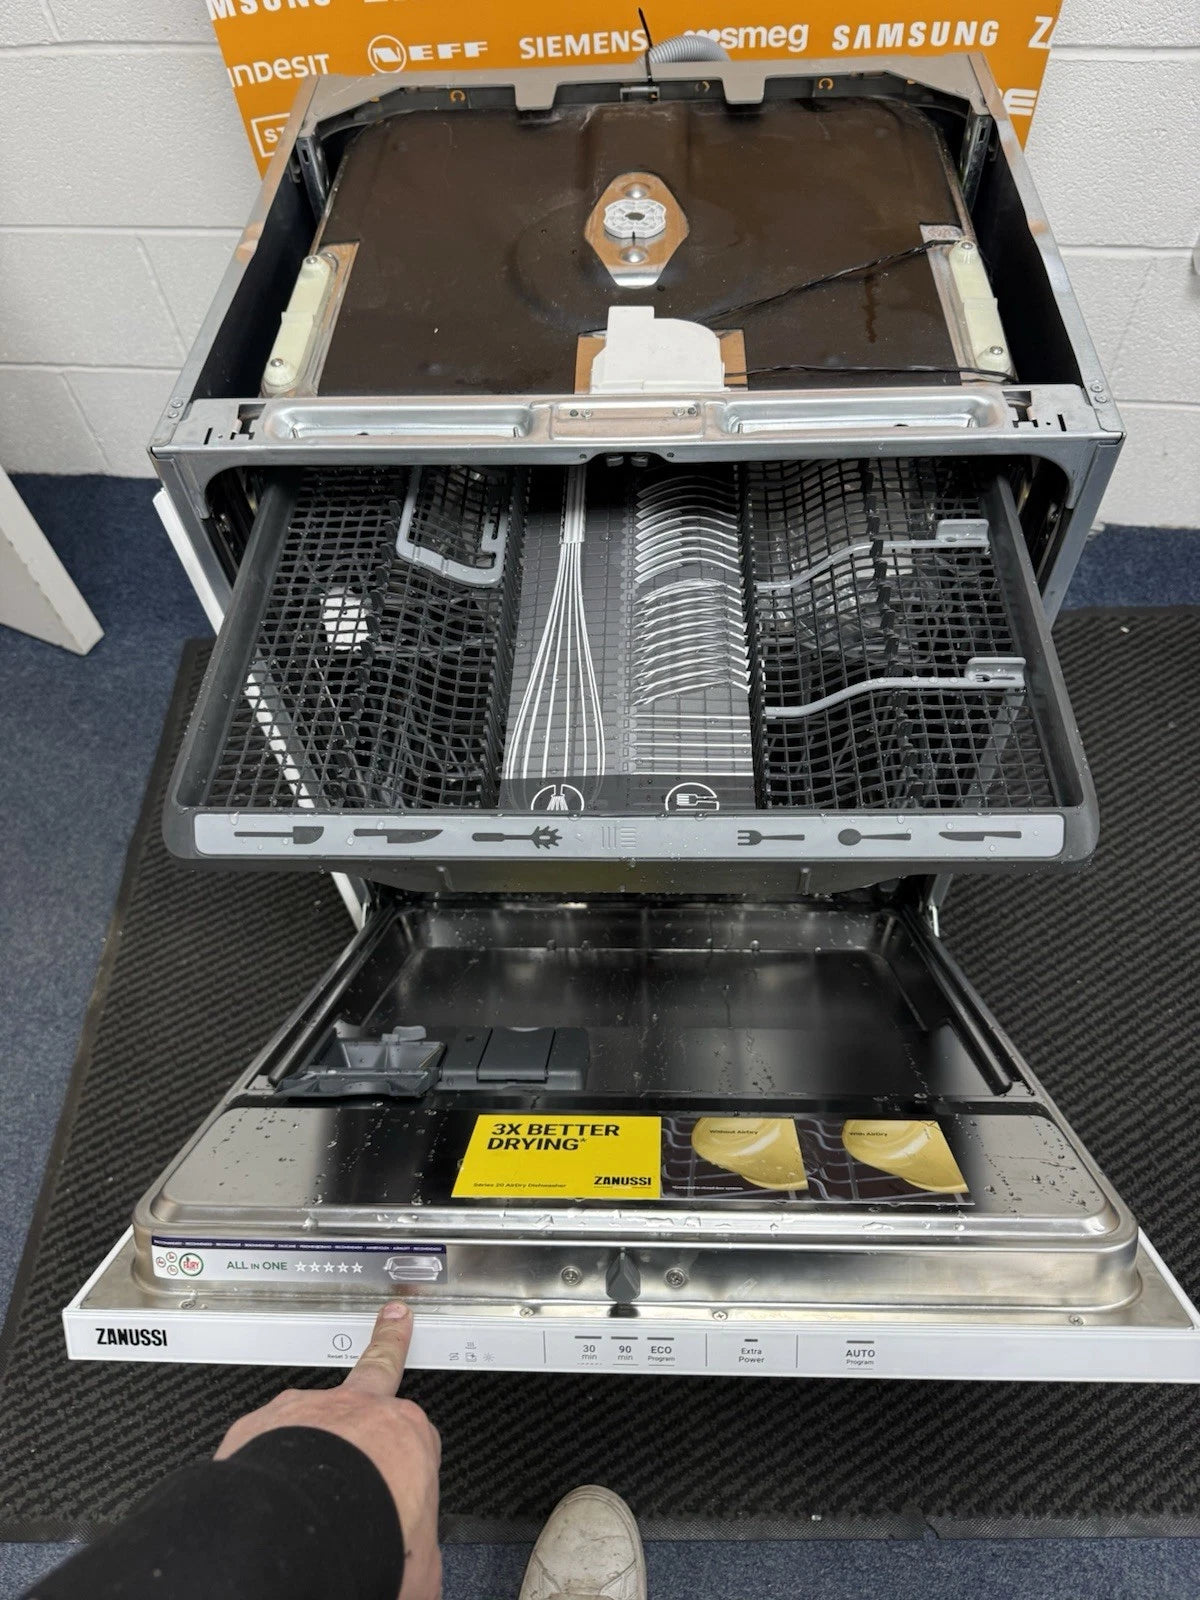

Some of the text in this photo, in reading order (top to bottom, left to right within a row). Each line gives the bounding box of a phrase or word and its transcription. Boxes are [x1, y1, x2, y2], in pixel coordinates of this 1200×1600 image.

[720, 24, 809, 53] smeg
[832, 20, 999, 50] SAMSUNG
[518, 28, 648, 59] SIEMENS
[492, 1123, 620, 1136] 3X BETTER
[594, 1176, 652, 1186] ZANUSSI
[227, 1261, 248, 1270] ALL
[262, 1261, 287, 1270] ONE
[94, 1327, 168, 1347] ZANUSSI
[583, 1345, 596, 1353] 30
[618, 1345, 632, 1354] 90
[650, 1345, 672, 1354] ECO
[741, 1347, 763, 1355] Extra
[845, 1348, 876, 1358] AUTO
[647, 1355, 676, 1363] Program
[738, 1355, 765, 1363] Power
[846, 1358, 874, 1366] Program
